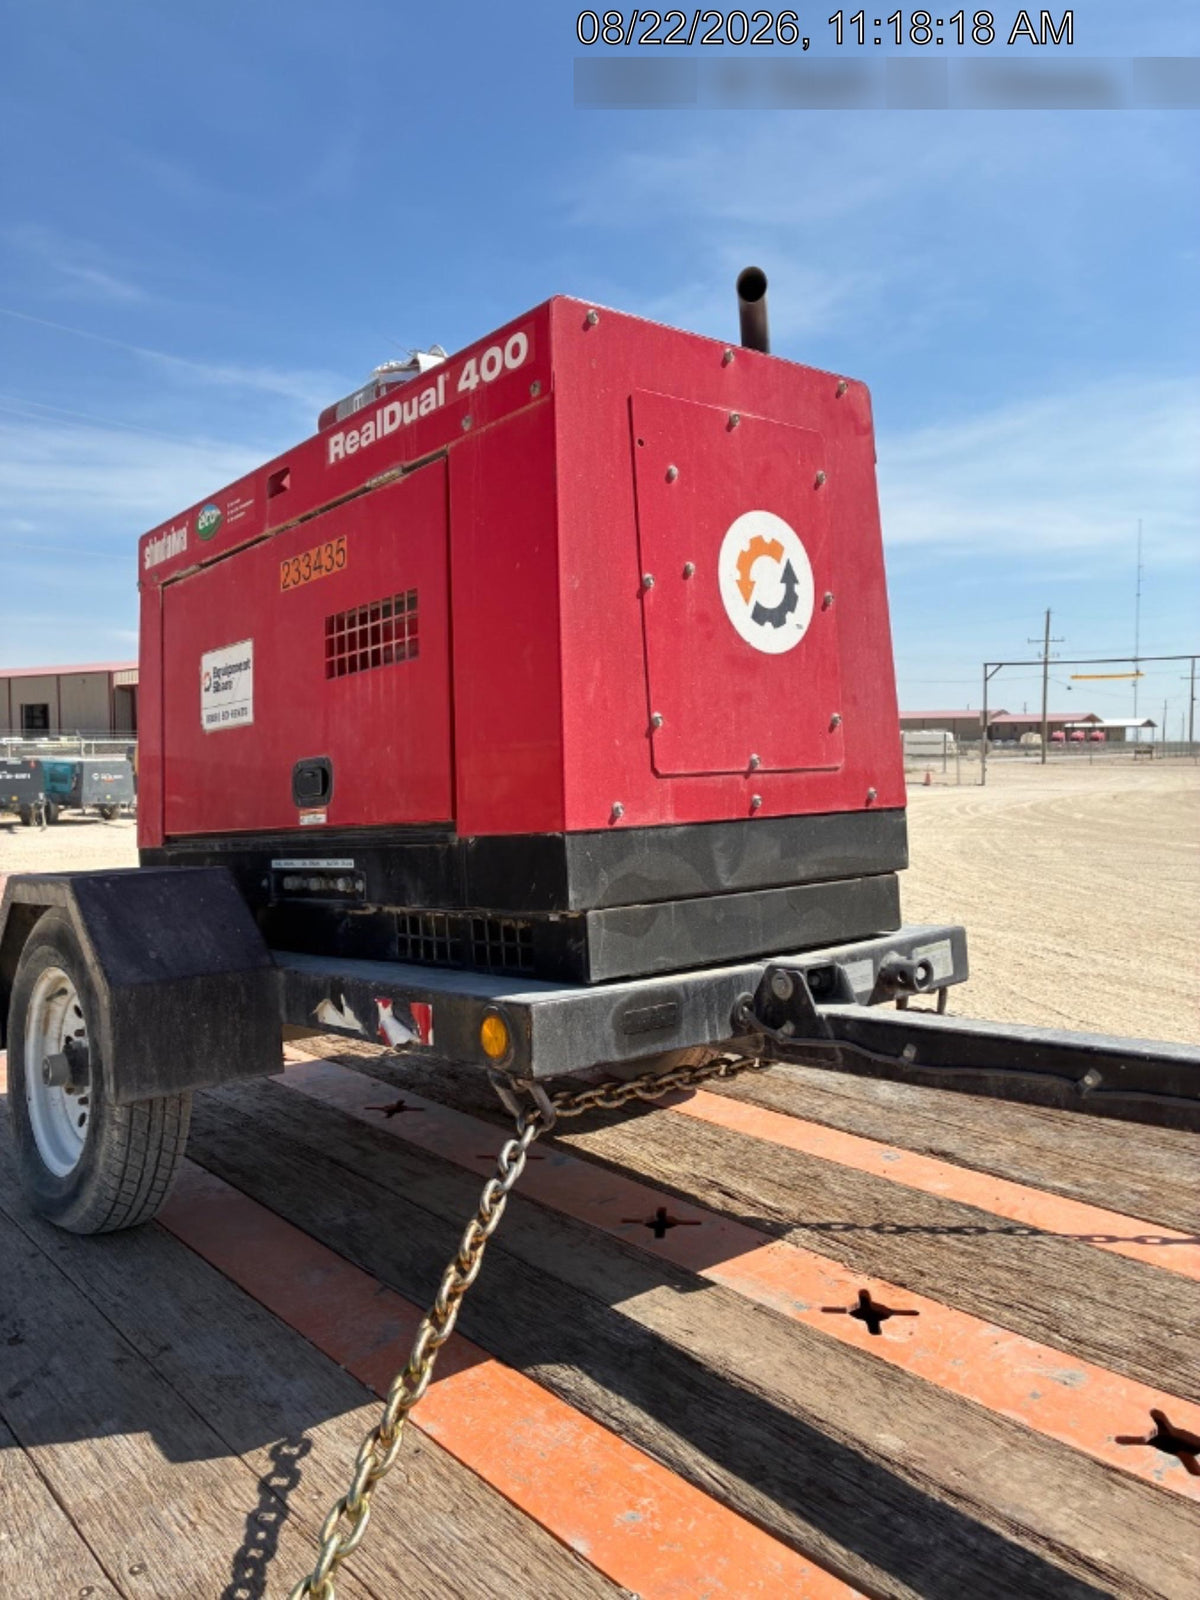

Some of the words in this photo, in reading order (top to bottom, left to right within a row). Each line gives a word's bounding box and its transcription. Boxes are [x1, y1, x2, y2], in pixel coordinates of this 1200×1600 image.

[328, 373, 446, 464] RealDual
[457, 331, 529, 392] 400
[281, 537, 347, 590] 233435
